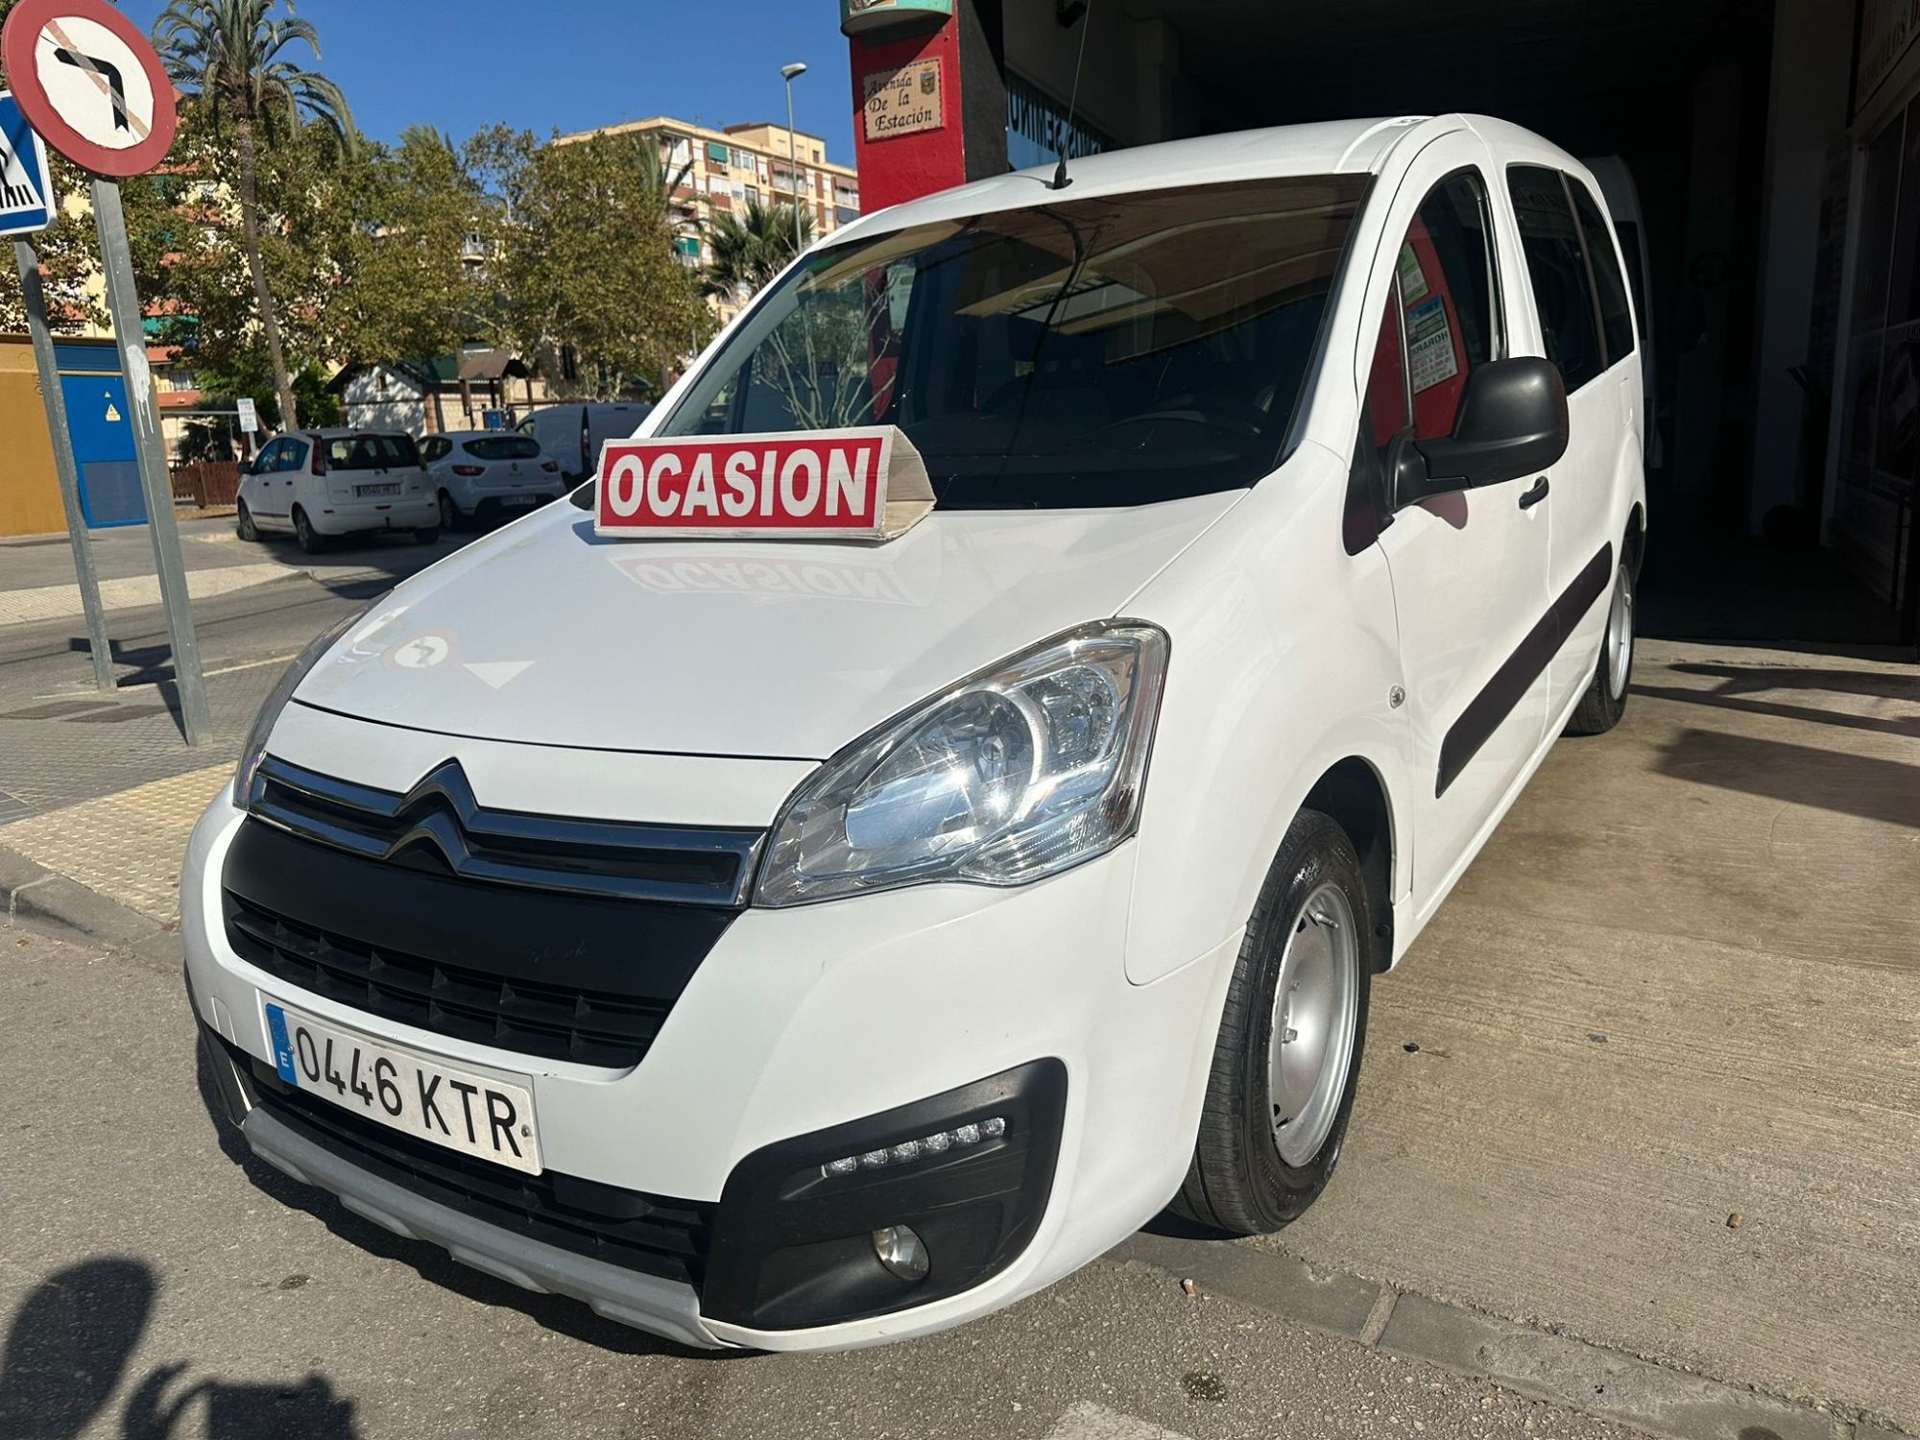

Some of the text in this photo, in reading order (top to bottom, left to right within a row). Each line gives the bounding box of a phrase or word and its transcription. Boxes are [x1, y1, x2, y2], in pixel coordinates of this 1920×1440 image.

[867, 71, 913, 96] Avenida
[869, 89, 910, 113] De la
[875, 106, 933, 131] Estación
[608, 448, 871, 517] OCASION
[279, 1052, 289, 1068] E
[296, 1026, 523, 1158] 0446 KTR
